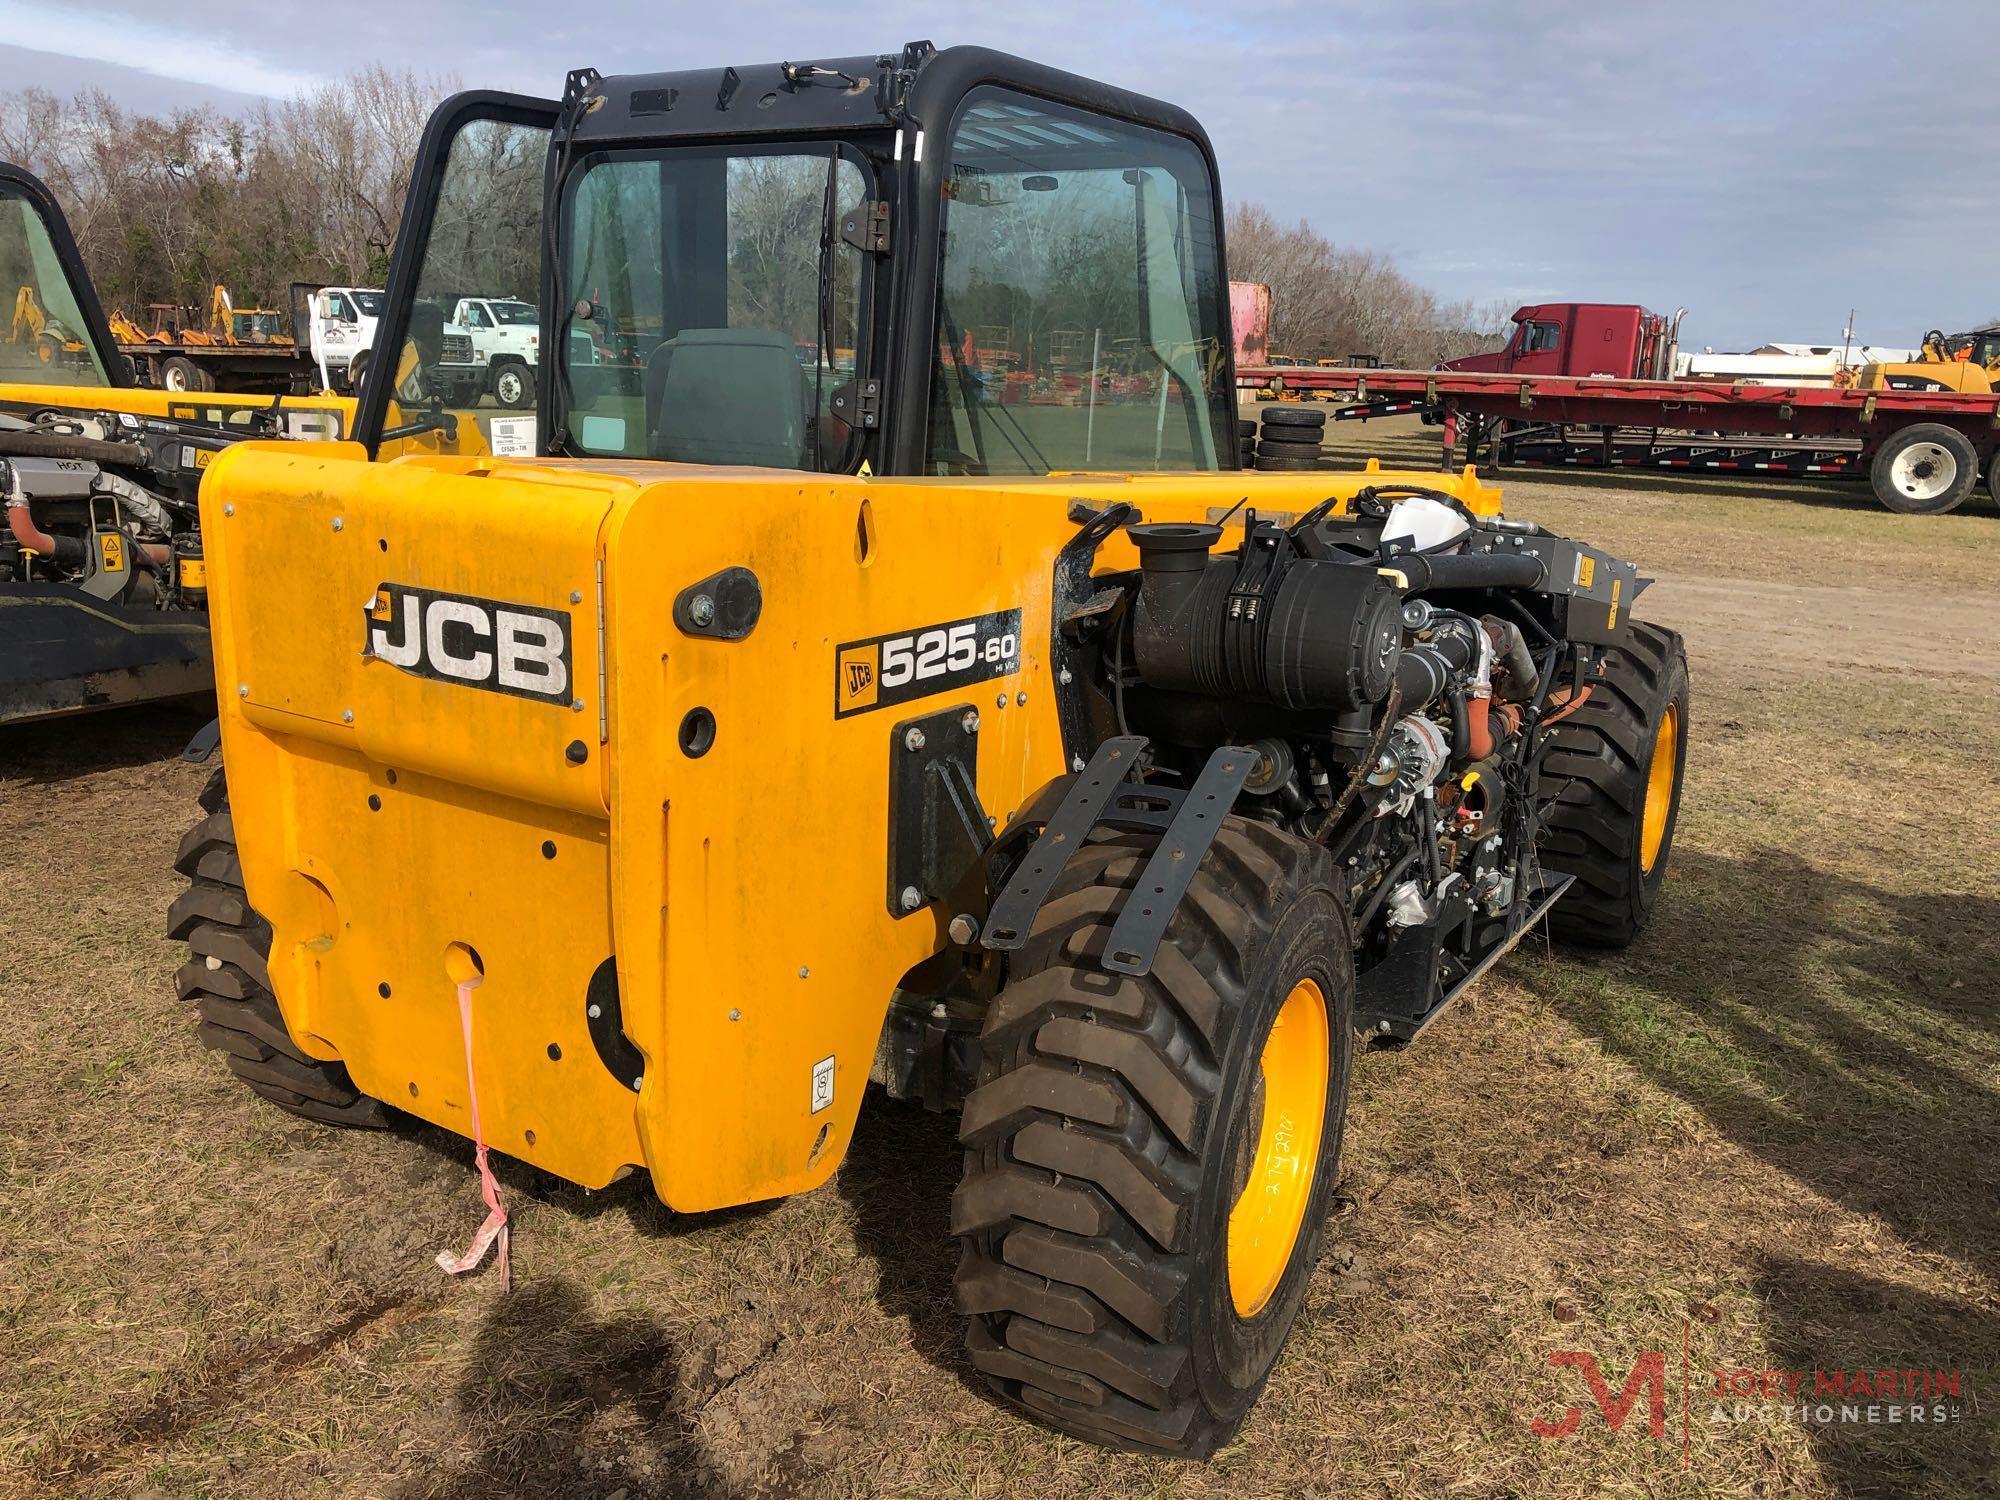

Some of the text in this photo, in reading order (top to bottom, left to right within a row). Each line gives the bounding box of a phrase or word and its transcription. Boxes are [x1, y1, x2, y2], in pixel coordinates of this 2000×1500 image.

[56, 461, 84, 471] HOT
[372, 594, 567, 695] JCB
[995, 661, 1015, 673] Hi Viz
[850, 663, 871, 693] JCB
